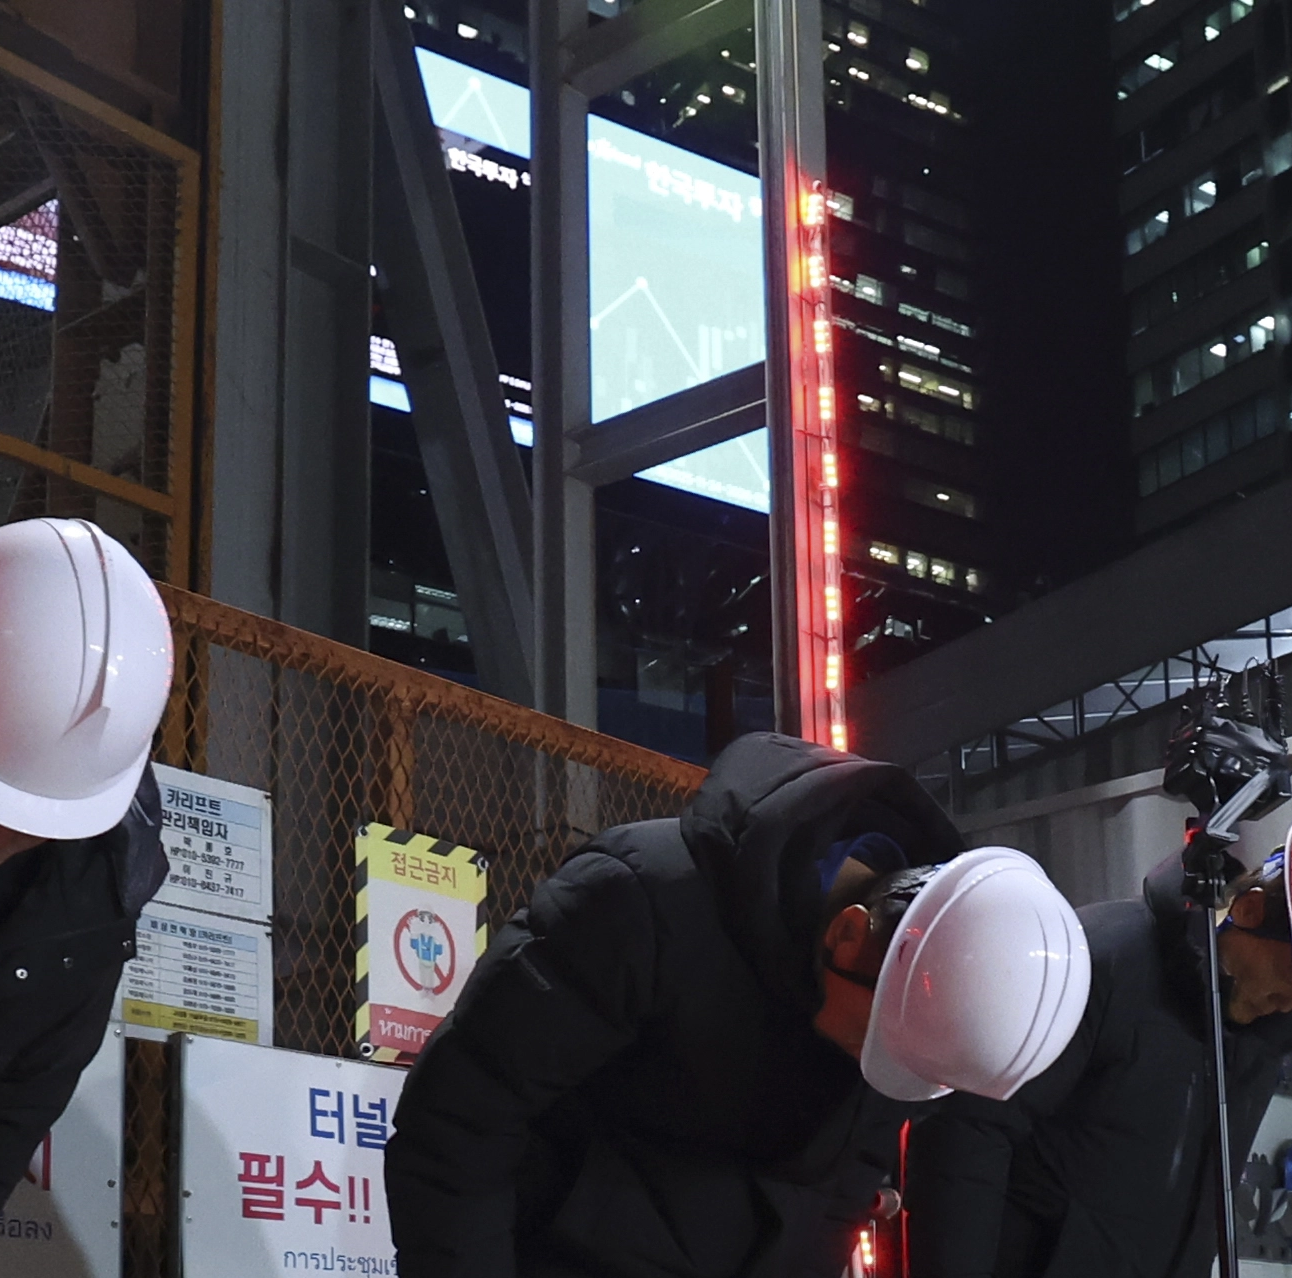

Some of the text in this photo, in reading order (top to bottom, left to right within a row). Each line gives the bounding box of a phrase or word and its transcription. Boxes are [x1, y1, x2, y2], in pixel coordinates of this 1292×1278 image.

[167, 788, 222, 816] 카리프트
[162, 809, 228, 840] 관리책임자
[391, 851, 457, 888] 접근금지
[309, 1087, 387, 1151] 터널
[238, 1151, 371, 1225] 필수!!
